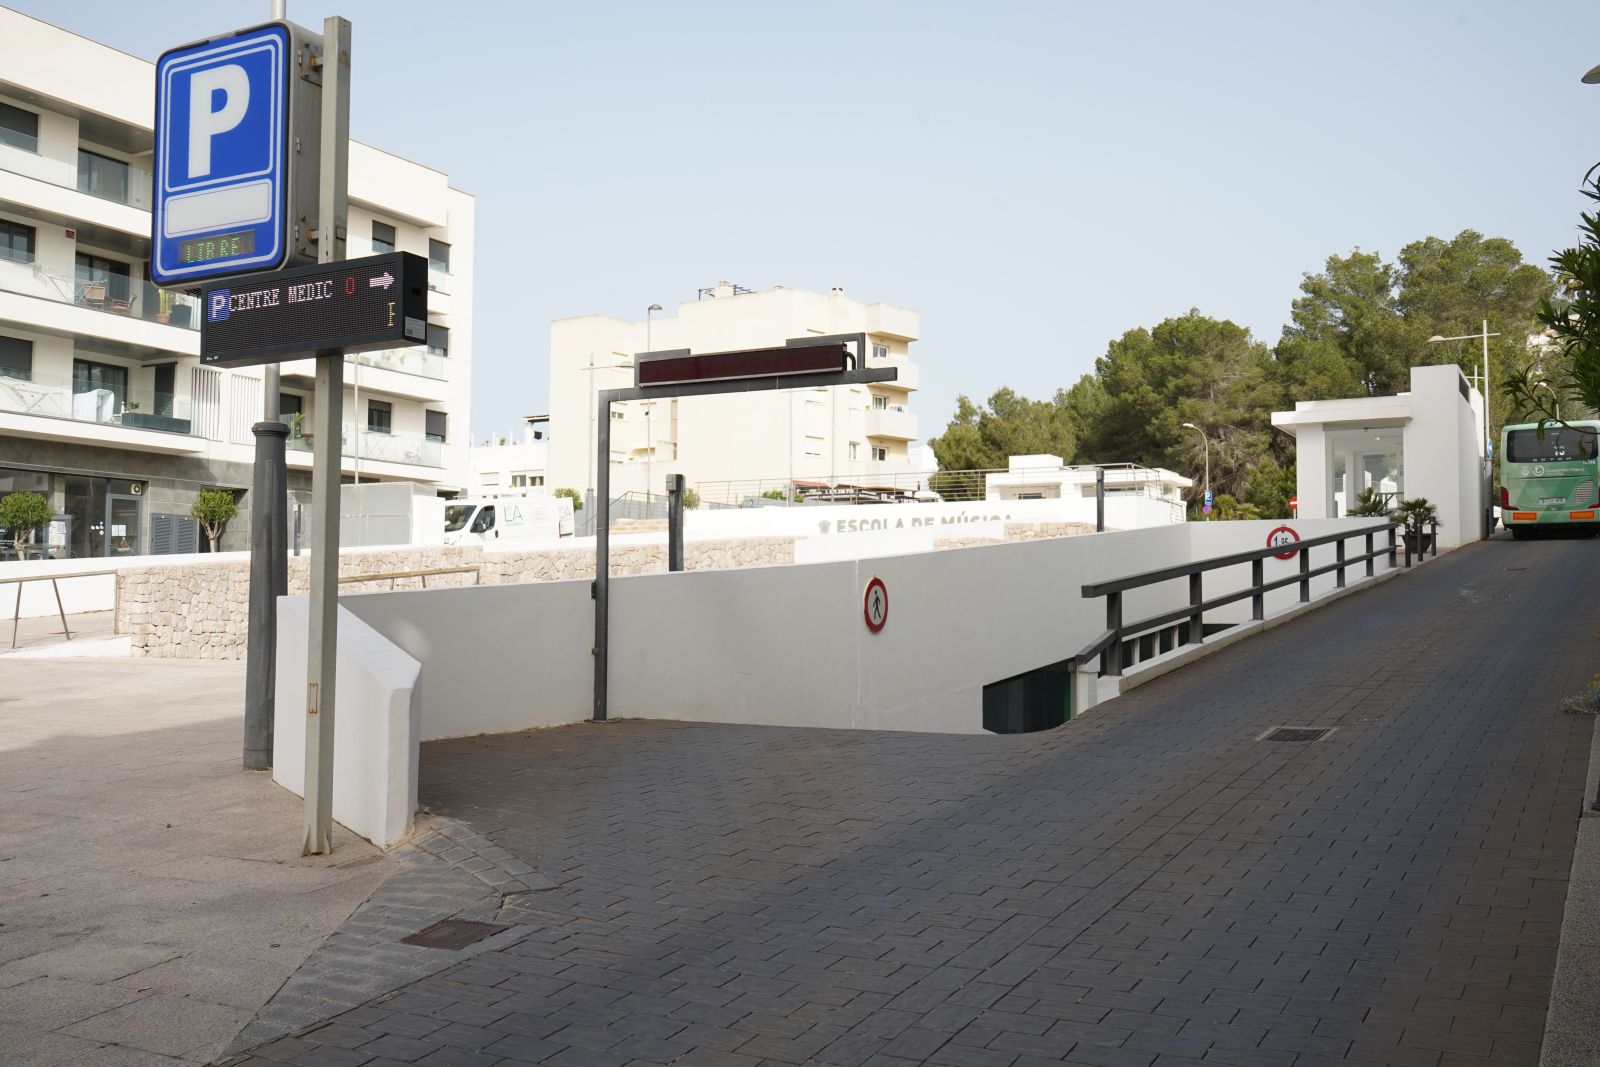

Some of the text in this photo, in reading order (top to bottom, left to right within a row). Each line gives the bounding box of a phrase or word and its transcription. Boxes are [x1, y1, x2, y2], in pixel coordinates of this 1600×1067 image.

[188, 64, 250, 179] P
[212, 295, 226, 318] P
[228, 288, 280, 312] CENTRE
[288, 280, 333, 304] MEDIC
[837, 518, 904, 533] ESCOLA
[912, 516, 935, 527] DE
